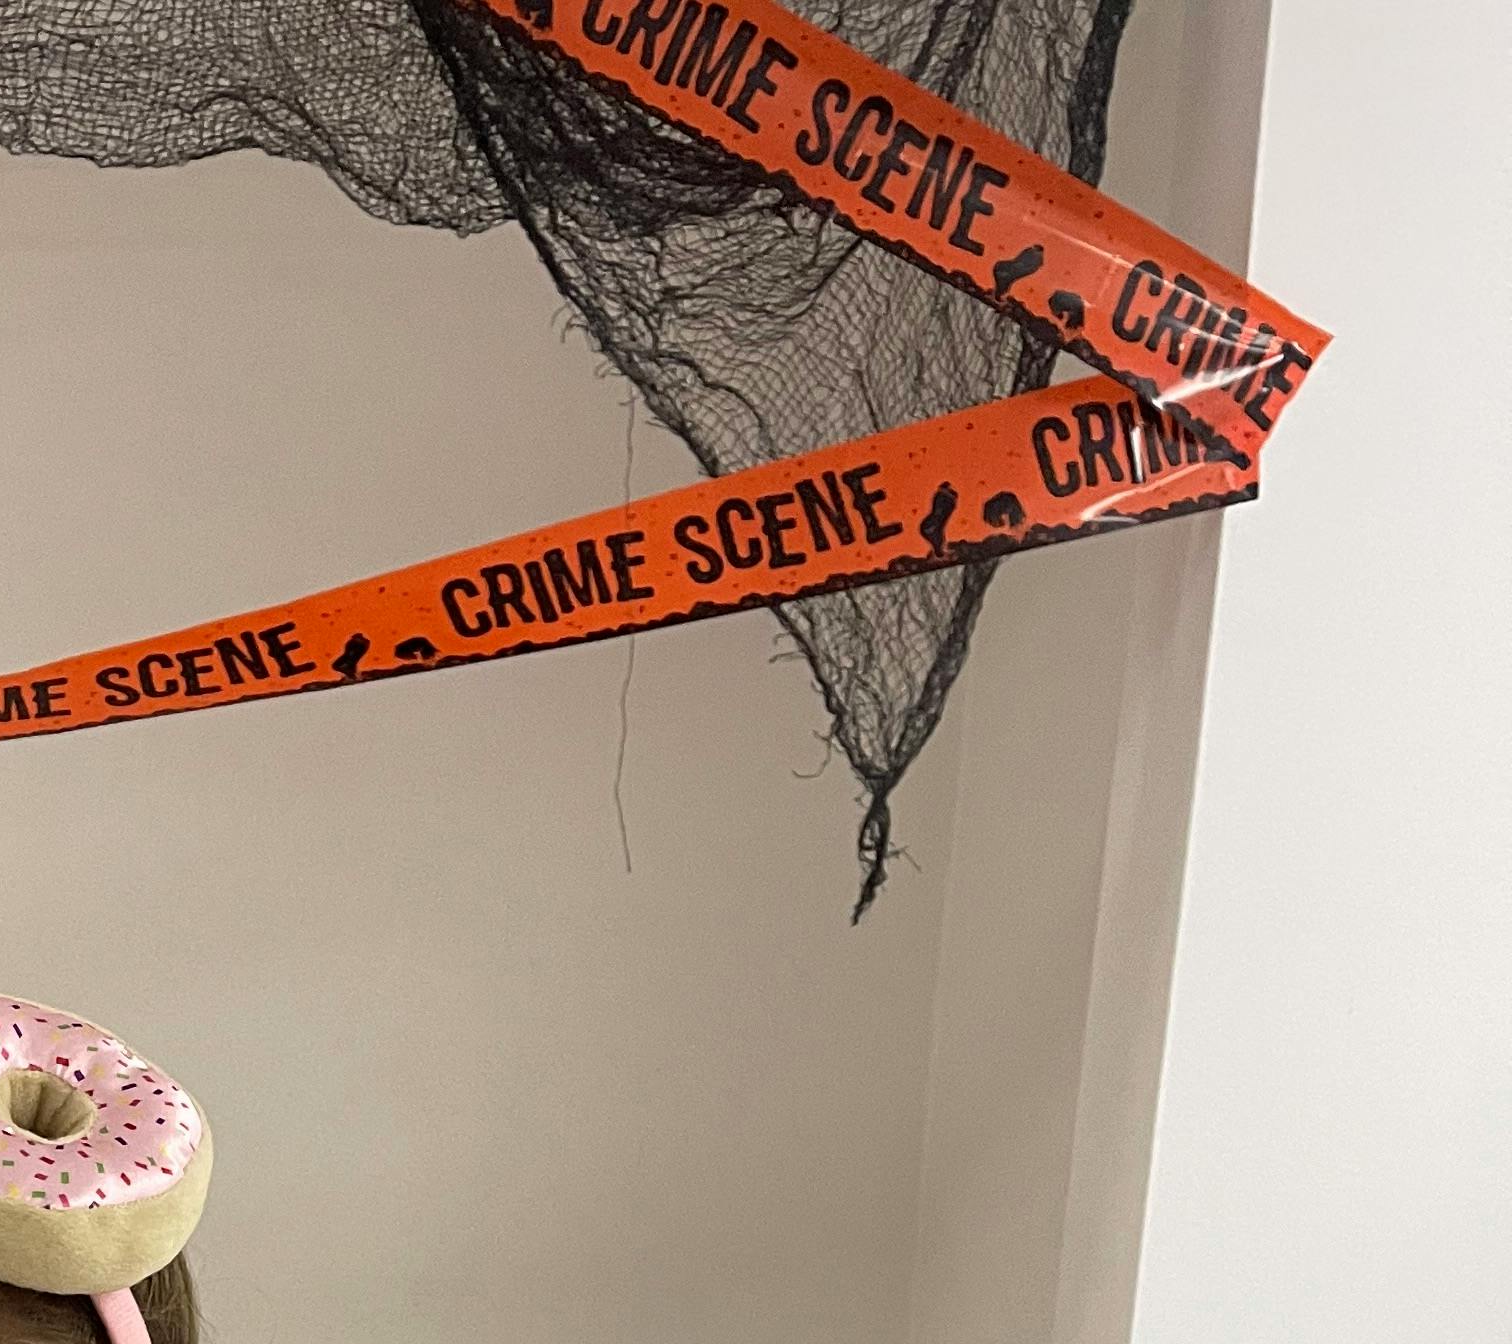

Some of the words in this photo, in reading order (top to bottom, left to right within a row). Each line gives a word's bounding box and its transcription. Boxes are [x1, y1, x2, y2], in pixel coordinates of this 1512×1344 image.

[581, 0, 799, 134] CRIME
[796, 77, 1011, 257] SCENE
[1111, 259, 1313, 432] CRIME
[95, 621, 319, 707] SCENE
[441, 529, 655, 639] CRIME
[673, 461, 905, 586] SCENE
